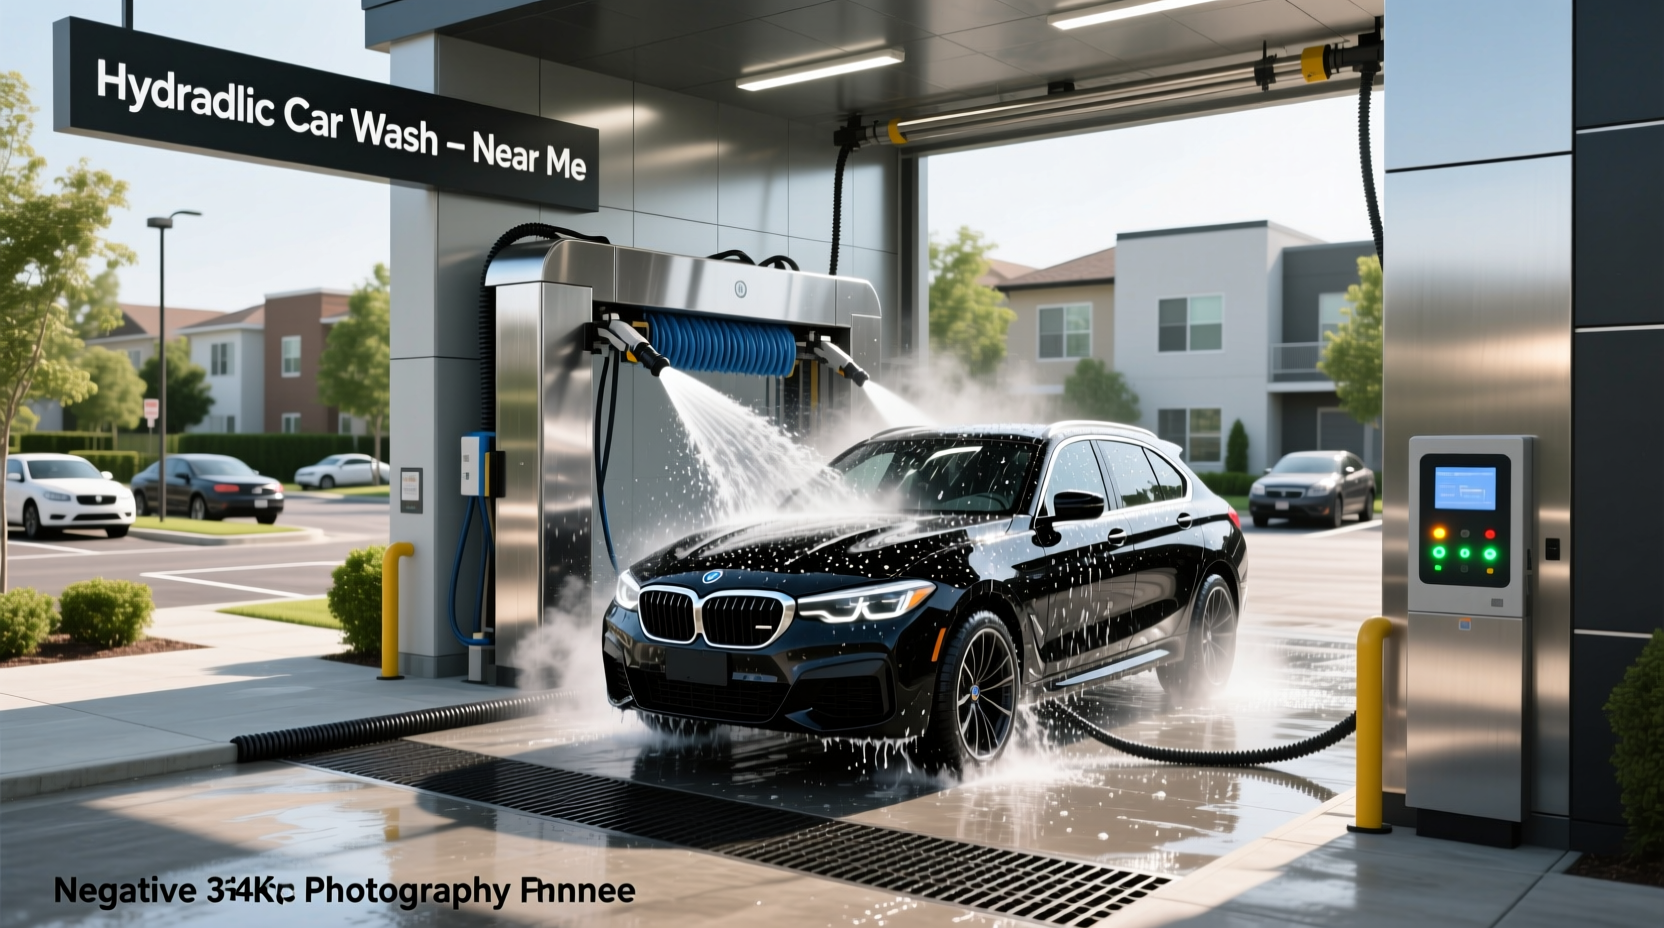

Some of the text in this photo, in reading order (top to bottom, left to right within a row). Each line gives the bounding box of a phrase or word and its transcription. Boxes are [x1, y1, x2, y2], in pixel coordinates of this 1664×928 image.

[96, 58, 275, 127] Hydradlic
[284, 96, 344, 139] Car
[350, 107, 438, 156] Wash
[473, 131, 540, 173] Near
[546, 145, 587, 181] Me
